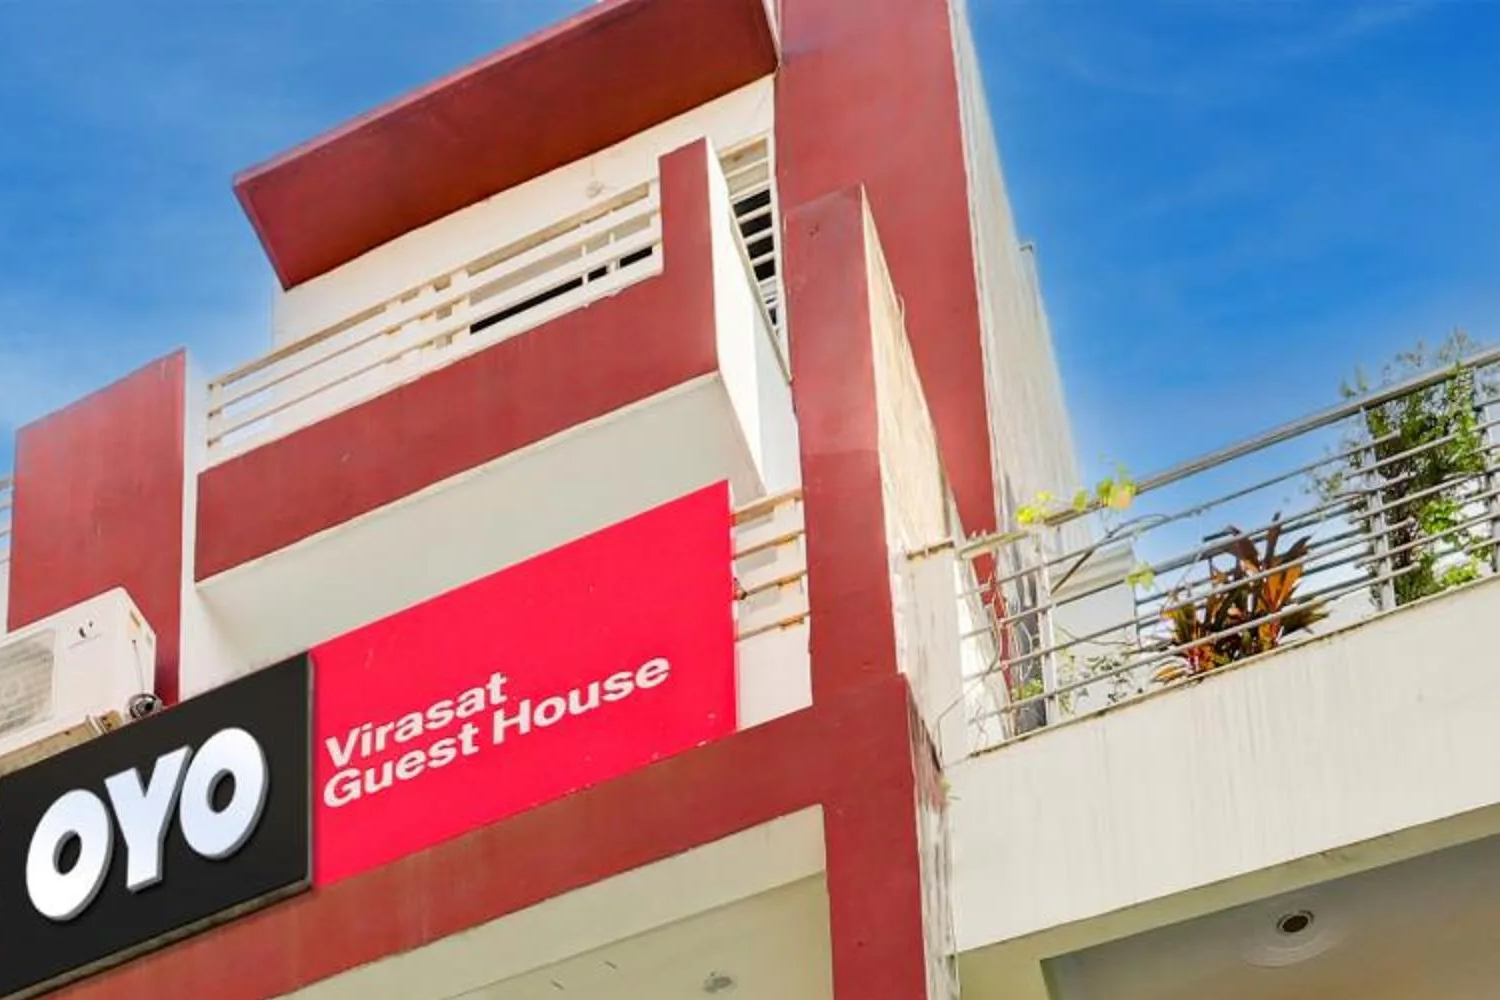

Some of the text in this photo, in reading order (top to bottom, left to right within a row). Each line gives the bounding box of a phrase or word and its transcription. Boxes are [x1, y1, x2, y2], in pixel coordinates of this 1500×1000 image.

[323, 656, 670, 809] Guest House
[324, 672, 508, 768] Virasat
[25, 726, 269, 922] OYO
